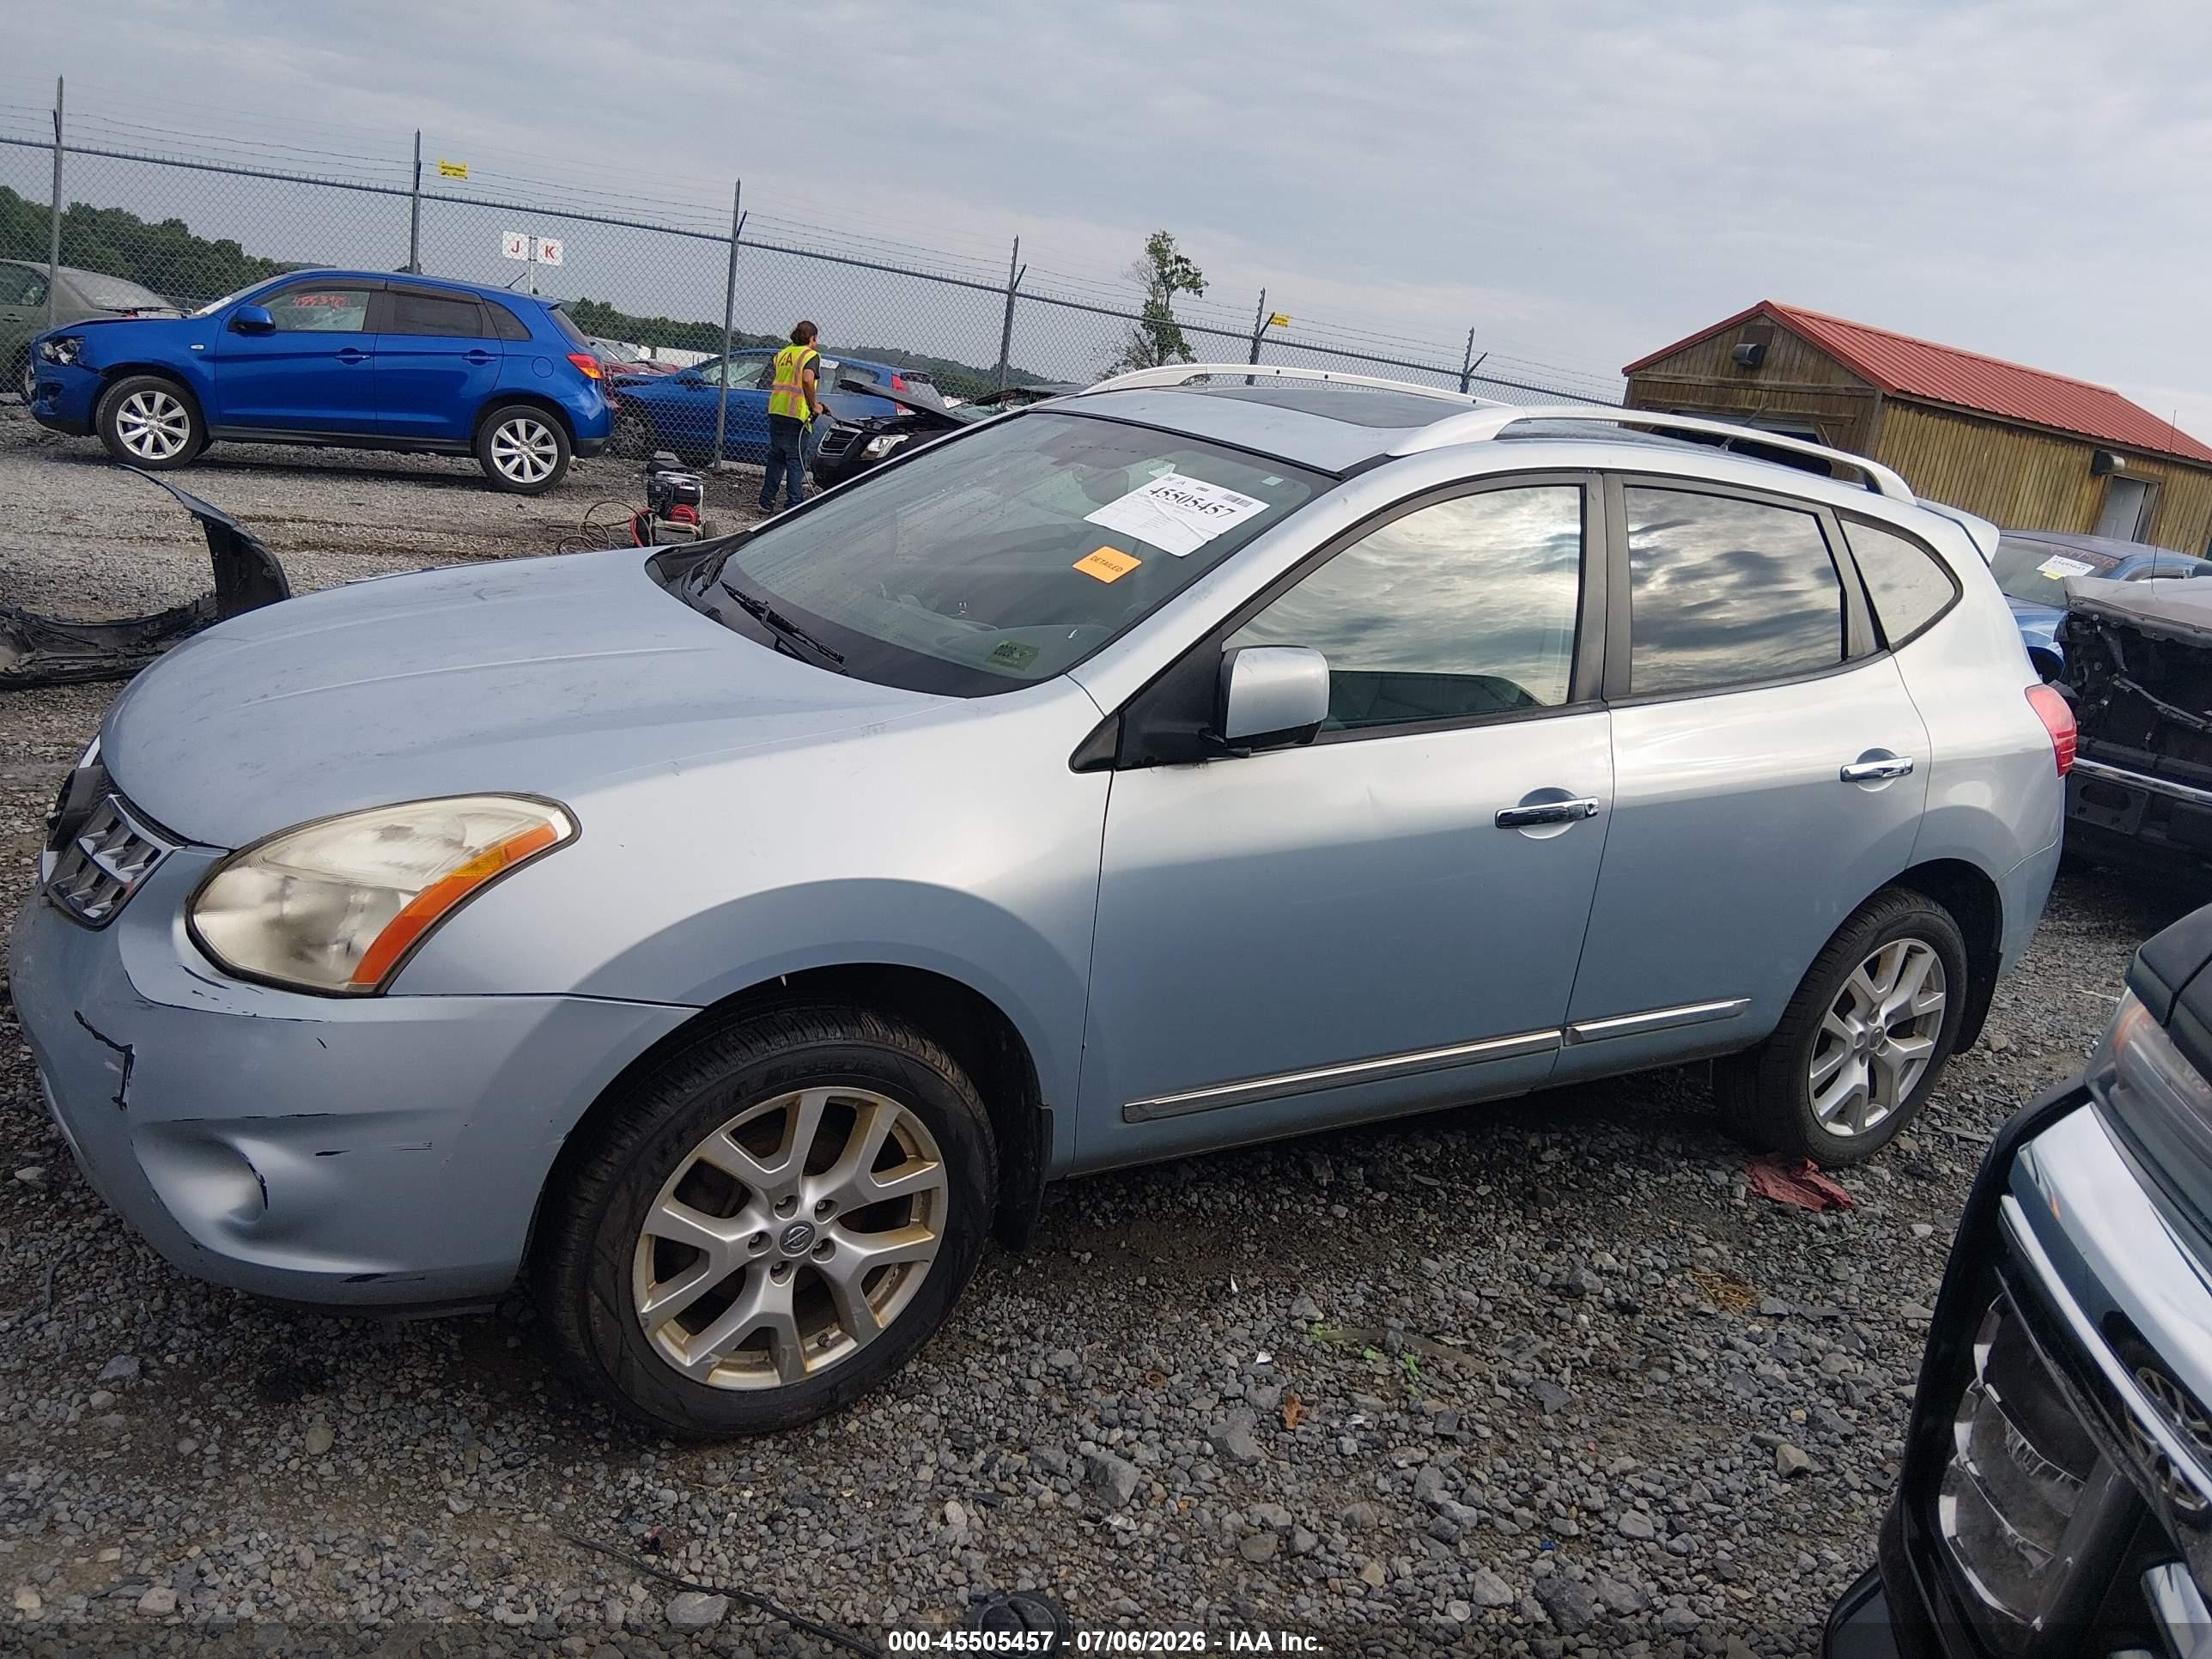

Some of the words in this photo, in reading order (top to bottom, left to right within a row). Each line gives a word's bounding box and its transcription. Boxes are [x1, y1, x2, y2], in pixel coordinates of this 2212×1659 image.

[510, 240, 520, 253] J
[544, 245, 556, 259] K
[1149, 486, 1237, 519] 45505457
[1090, 555, 1124, 574] DETAILED
